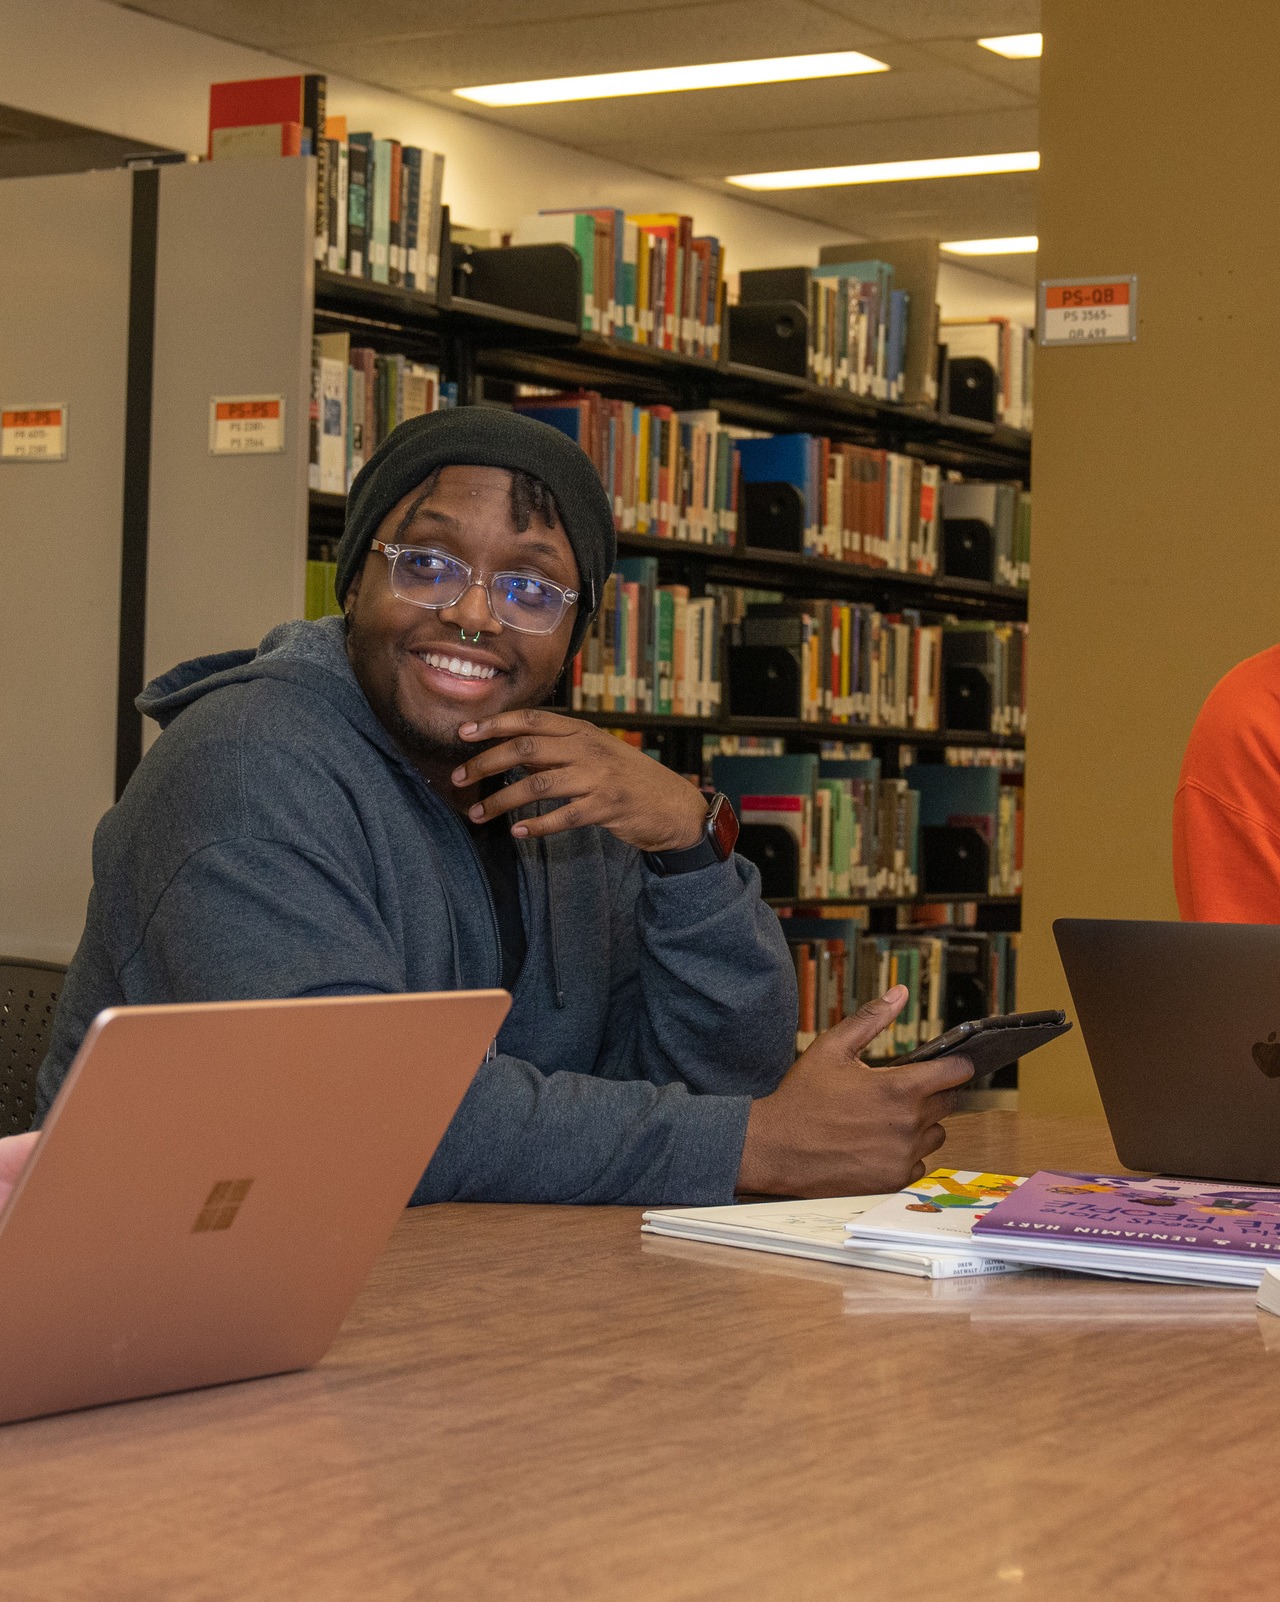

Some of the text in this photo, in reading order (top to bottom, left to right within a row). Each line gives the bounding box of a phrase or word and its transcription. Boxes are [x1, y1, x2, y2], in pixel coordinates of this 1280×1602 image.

[1062, 287, 1114, 306] PS-QB
[1063, 310, 1078, 322] PS
[228, 402, 269, 418] PS-PS
[1038, 1207, 1116, 1223] More
[1042, 1199, 1216, 1225] PEOPLE
[1002, 1220, 1061, 1231] HART
[1125, 1217, 1226, 1232] Needs
[1073, 1226, 1197, 1244] BENJAMIN
[1212, 1238, 1231, 1246] &
[952, 1267, 978, 1275] DAYWALT
[957, 1261, 973, 1269] DREW
[983, 1265, 1006, 1273] JEFFERS
